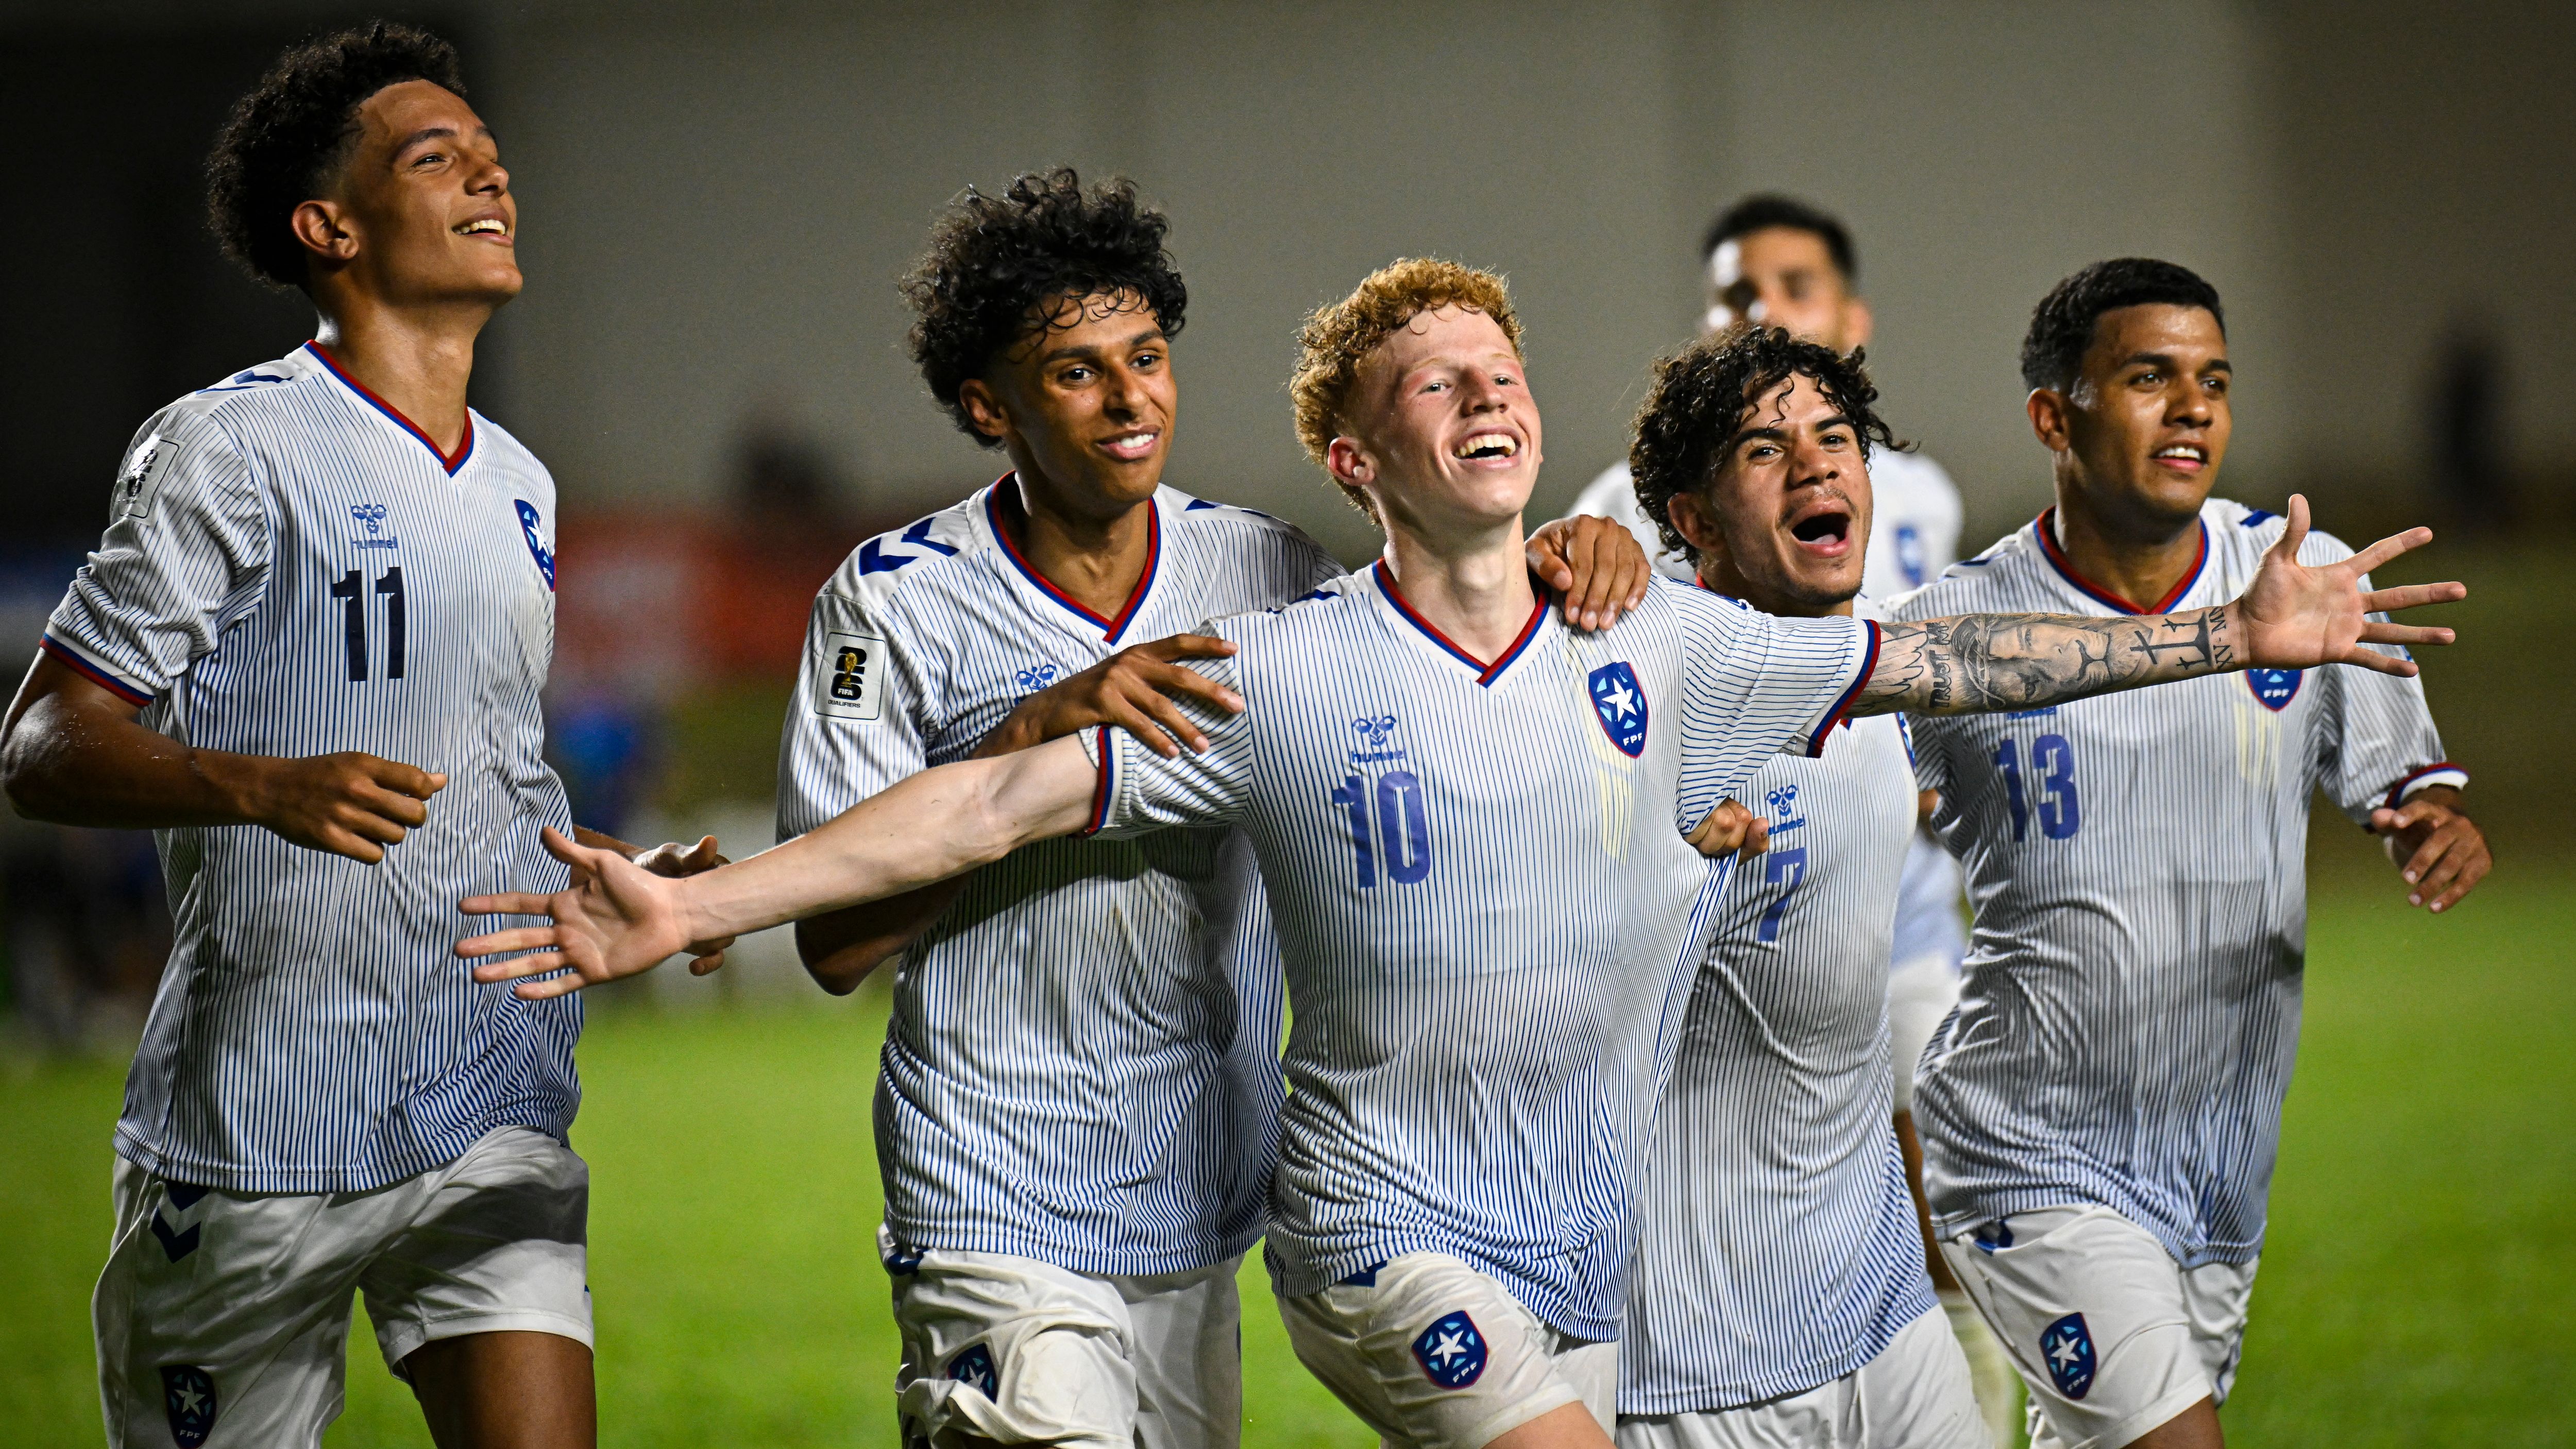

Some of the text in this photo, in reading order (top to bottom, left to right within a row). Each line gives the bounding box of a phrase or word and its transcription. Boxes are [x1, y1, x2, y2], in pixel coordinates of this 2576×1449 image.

[331, 567, 405, 682] 11
[827, 699, 861, 708] QUALIFIERS
[837, 688, 854, 696] FIFA
[1929, 650, 1952, 708] TRUST
[1623, 732, 1642, 746] FPF
[1995, 734, 2079, 842] 13
[1332, 771, 1431, 888] 10
[1757, 847, 1806, 942] 7
[179, 1429, 200, 1439] FPF
